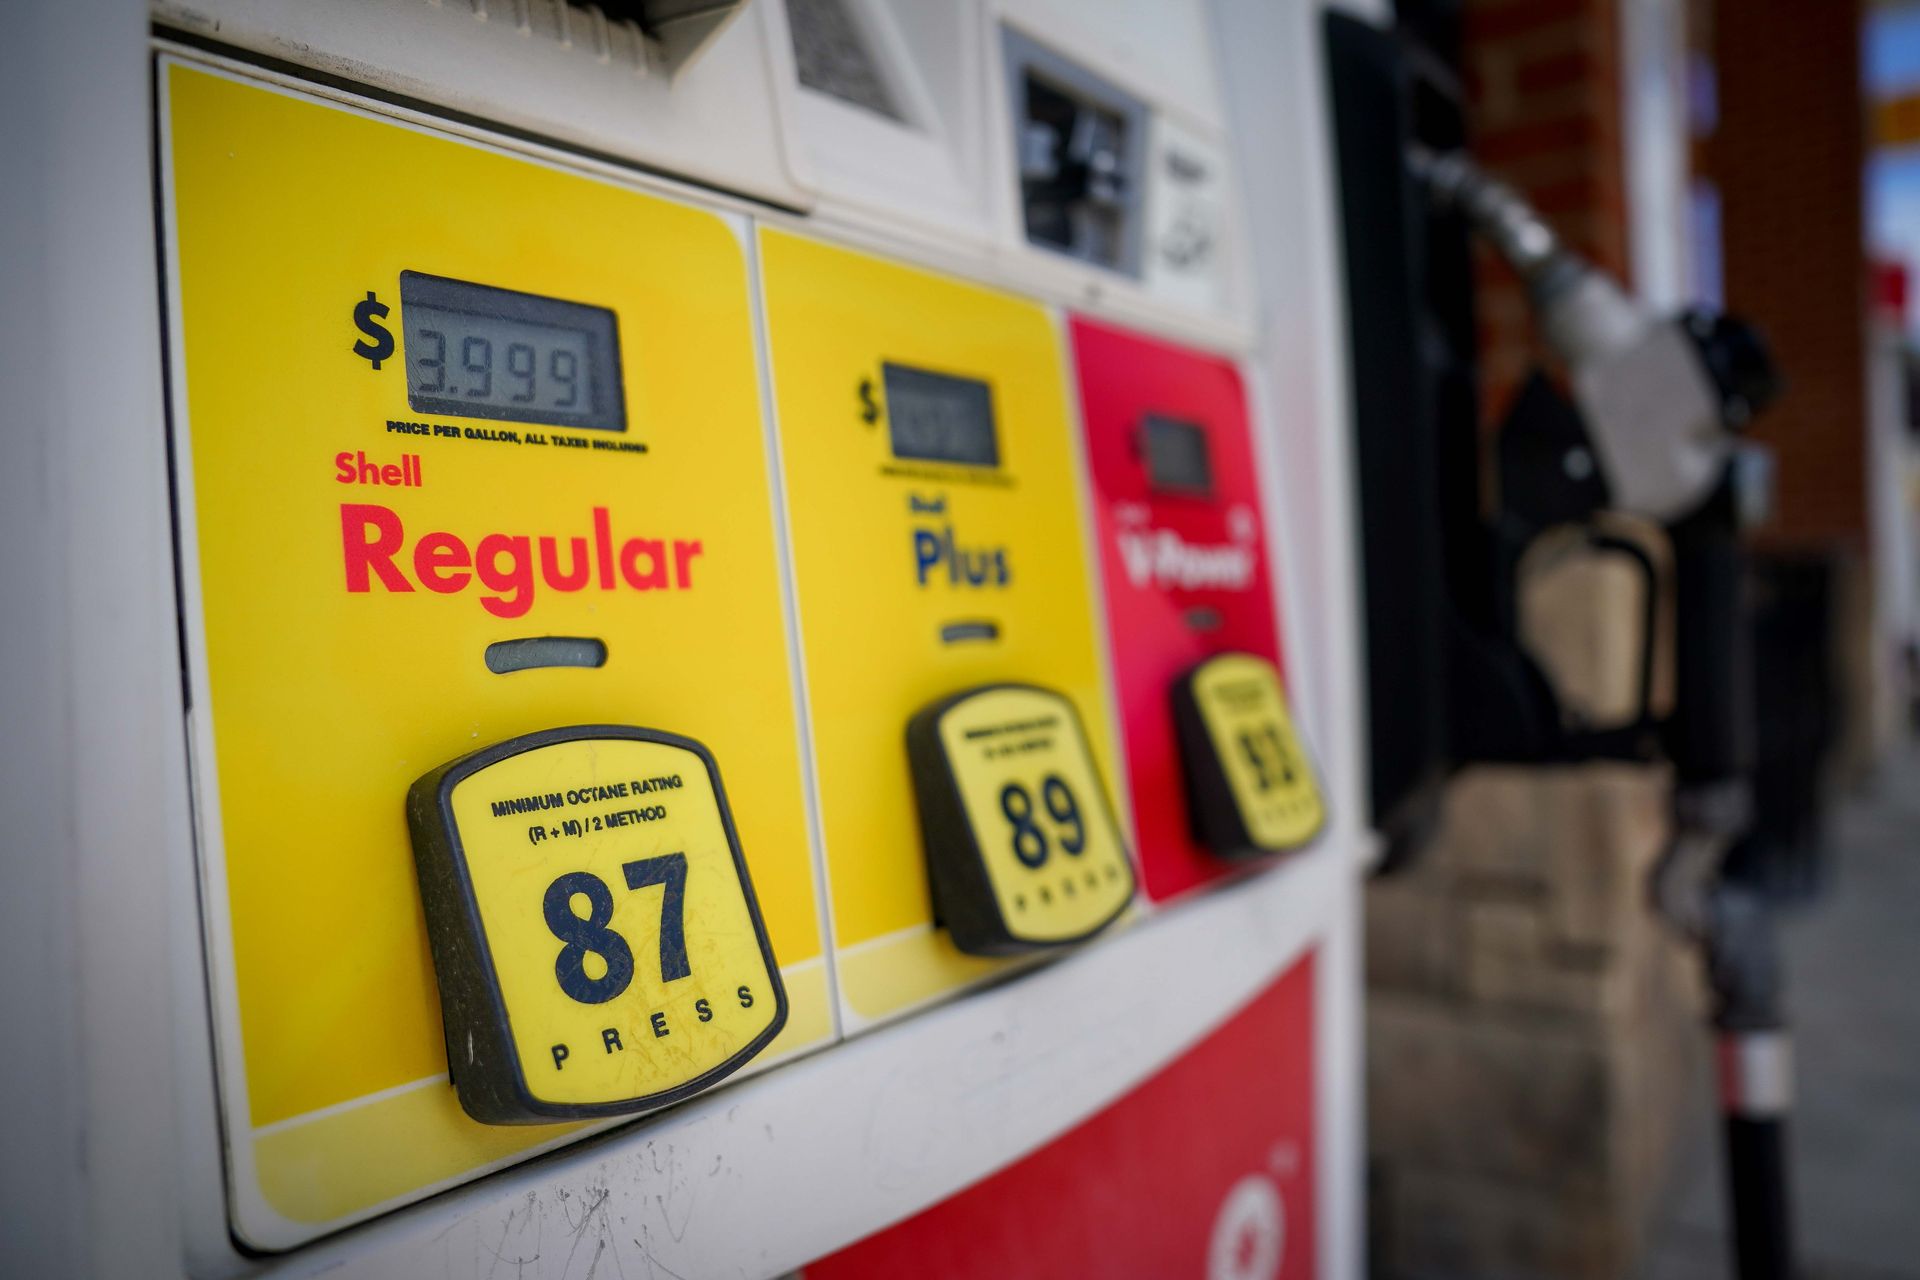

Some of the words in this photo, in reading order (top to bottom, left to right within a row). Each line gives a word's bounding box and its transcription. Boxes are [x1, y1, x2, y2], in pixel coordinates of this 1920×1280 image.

[353, 291, 395, 370] $
[418, 328, 579, 407] 3.999
[335, 451, 422, 487] Shell
[386, 420, 430, 436] PRICE
[433, 425, 461, 438] PER
[464, 427, 522, 445] GALLON,
[525, 433, 548, 445] ALL
[551, 435, 589, 449] TAXES
[340, 503, 704, 619] Regular
[913, 526, 1011, 587] Plus
[491, 793, 564, 817] MINIMUM
[566, 783, 629, 806] OCTANE
[630, 774, 683, 795] RATING
[592, 817, 603, 831] 2
[604, 805, 667, 828] METHOD
[1000, 774, 1087, 868] 89
[543, 851, 692, 1004] 87
[552, 985, 754, 1070] PRESS
